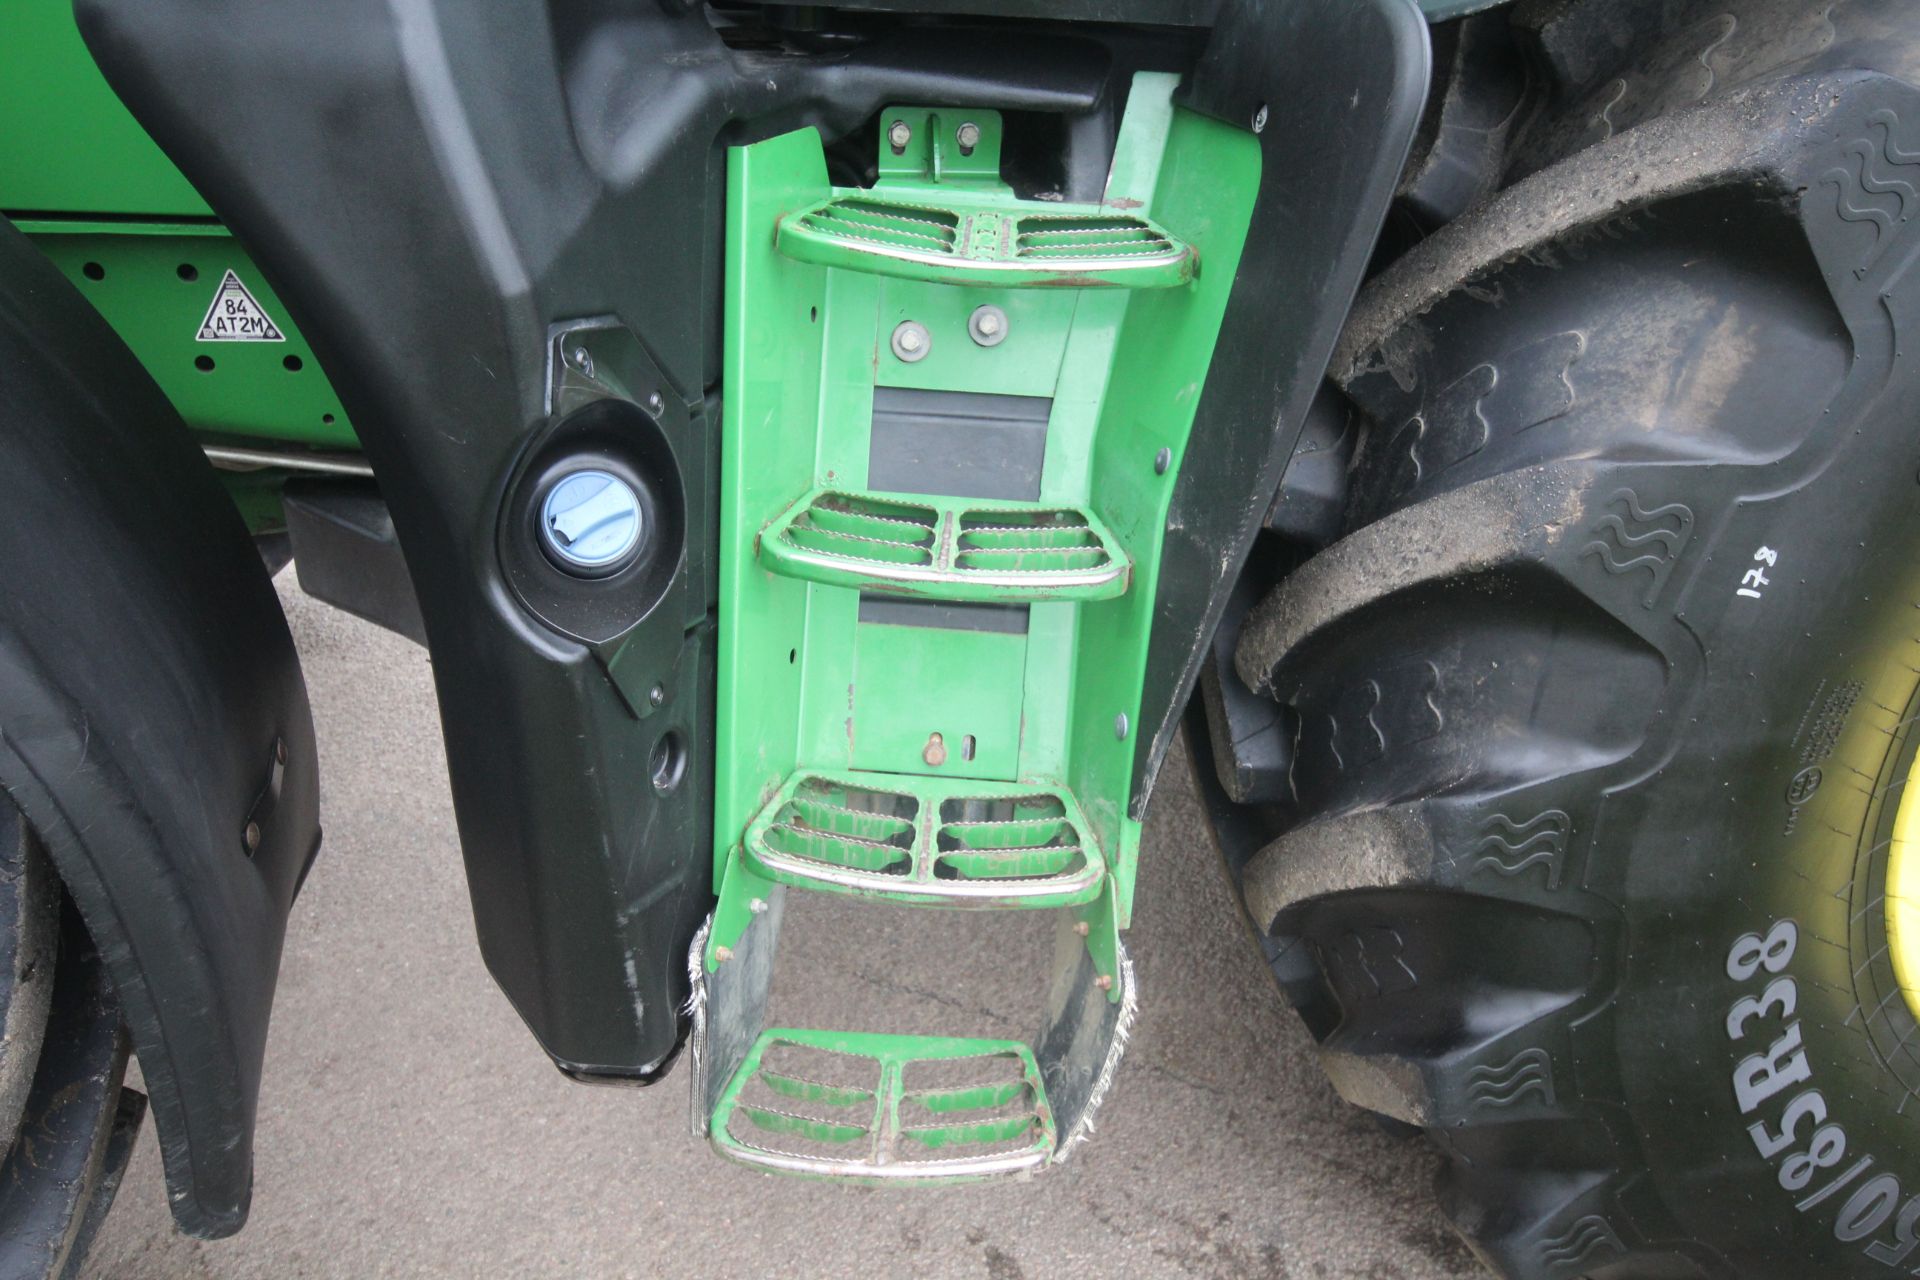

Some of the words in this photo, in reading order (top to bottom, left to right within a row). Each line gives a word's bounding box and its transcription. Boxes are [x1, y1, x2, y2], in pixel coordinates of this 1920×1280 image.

[225, 299, 247, 315] 84
[217, 317, 264, 333] AT2M
[1736, 545, 1778, 599] 178
[1726, 919, 1920, 1280] 50/85R38
